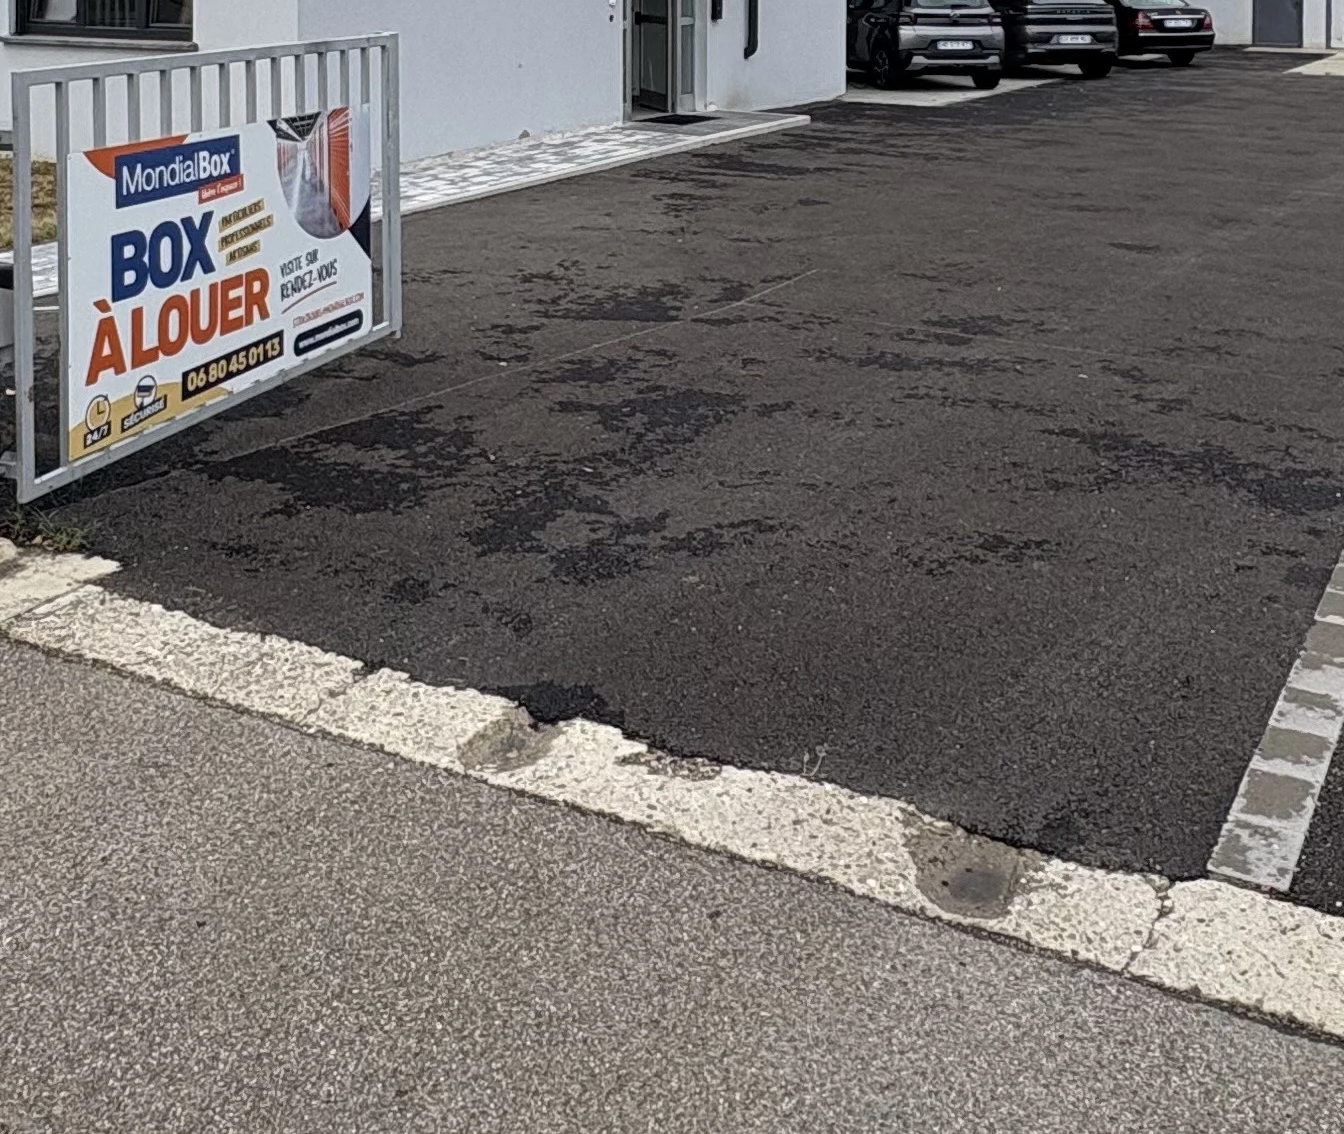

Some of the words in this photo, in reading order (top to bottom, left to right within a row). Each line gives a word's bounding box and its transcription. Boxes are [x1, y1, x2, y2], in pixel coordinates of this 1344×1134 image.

[122, 150, 231, 196] MondialBox
[111, 210, 216, 303] BOX
[279, 254, 303, 278] VISITE
[305, 248, 319, 267] SUR
[85, 298, 126, 386] À
[130, 267, 271, 369] LOUER
[85, 424, 109, 445] 24/7
